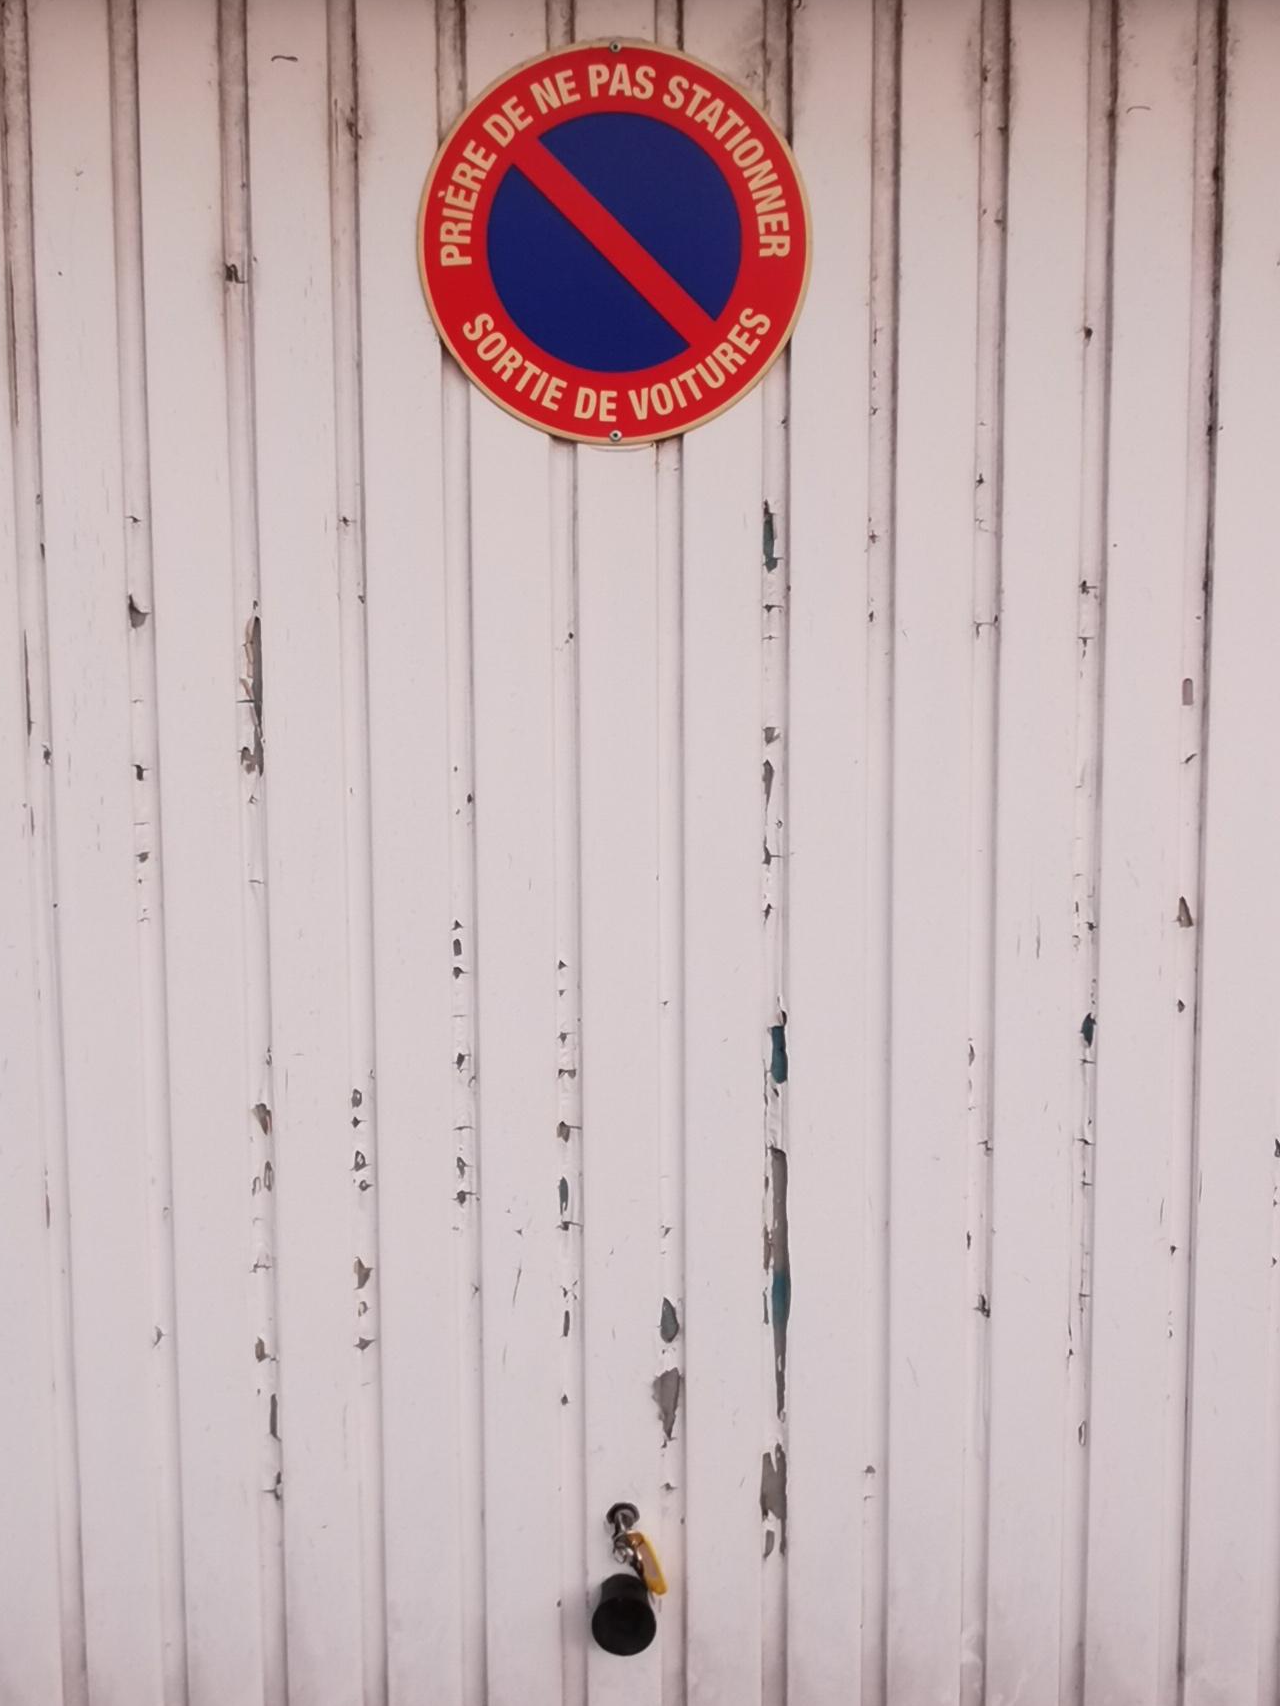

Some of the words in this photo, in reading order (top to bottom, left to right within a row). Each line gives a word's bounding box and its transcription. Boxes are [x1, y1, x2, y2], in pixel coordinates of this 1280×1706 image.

[439, 140, 497, 267] PRIÈRE
[483, 96, 533, 147] DE
[530, 69, 581, 114] NE
[588, 63, 656, 99] PAS
[662, 75, 791, 259] STATIONNER
[462, 312, 568, 411] SORTIE
[574, 387, 617, 422] DE
[628, 307, 771, 420] VOITURES
